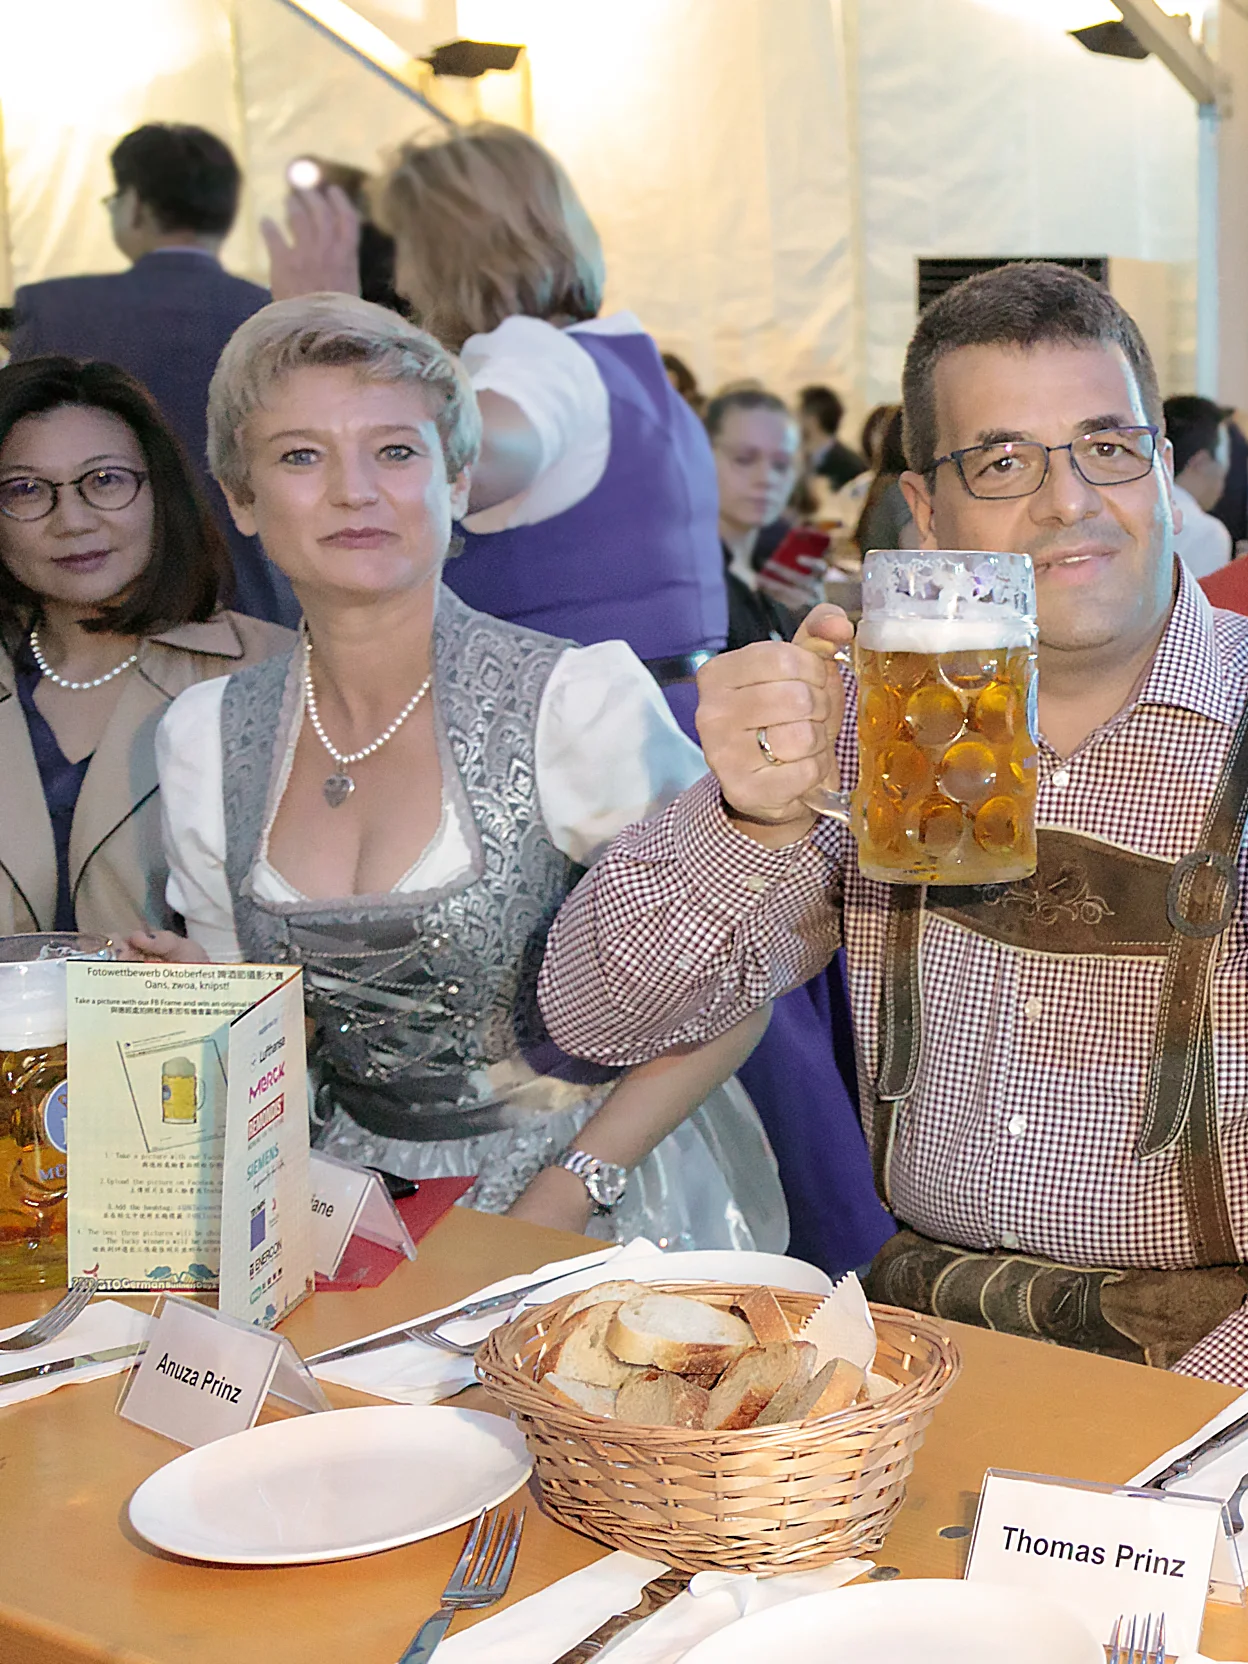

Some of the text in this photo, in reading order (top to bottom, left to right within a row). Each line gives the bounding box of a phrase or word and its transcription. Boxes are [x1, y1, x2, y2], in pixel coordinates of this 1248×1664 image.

[87, 967, 160, 977] Fotowettbewerb
[163, 968, 215, 978] Oktoberfest
[248, 1061, 286, 1104] MERCK
[155, 1352, 243, 1404] Anuza Prinz
[1003, 1525, 1186, 1578] Thomas Prinz
